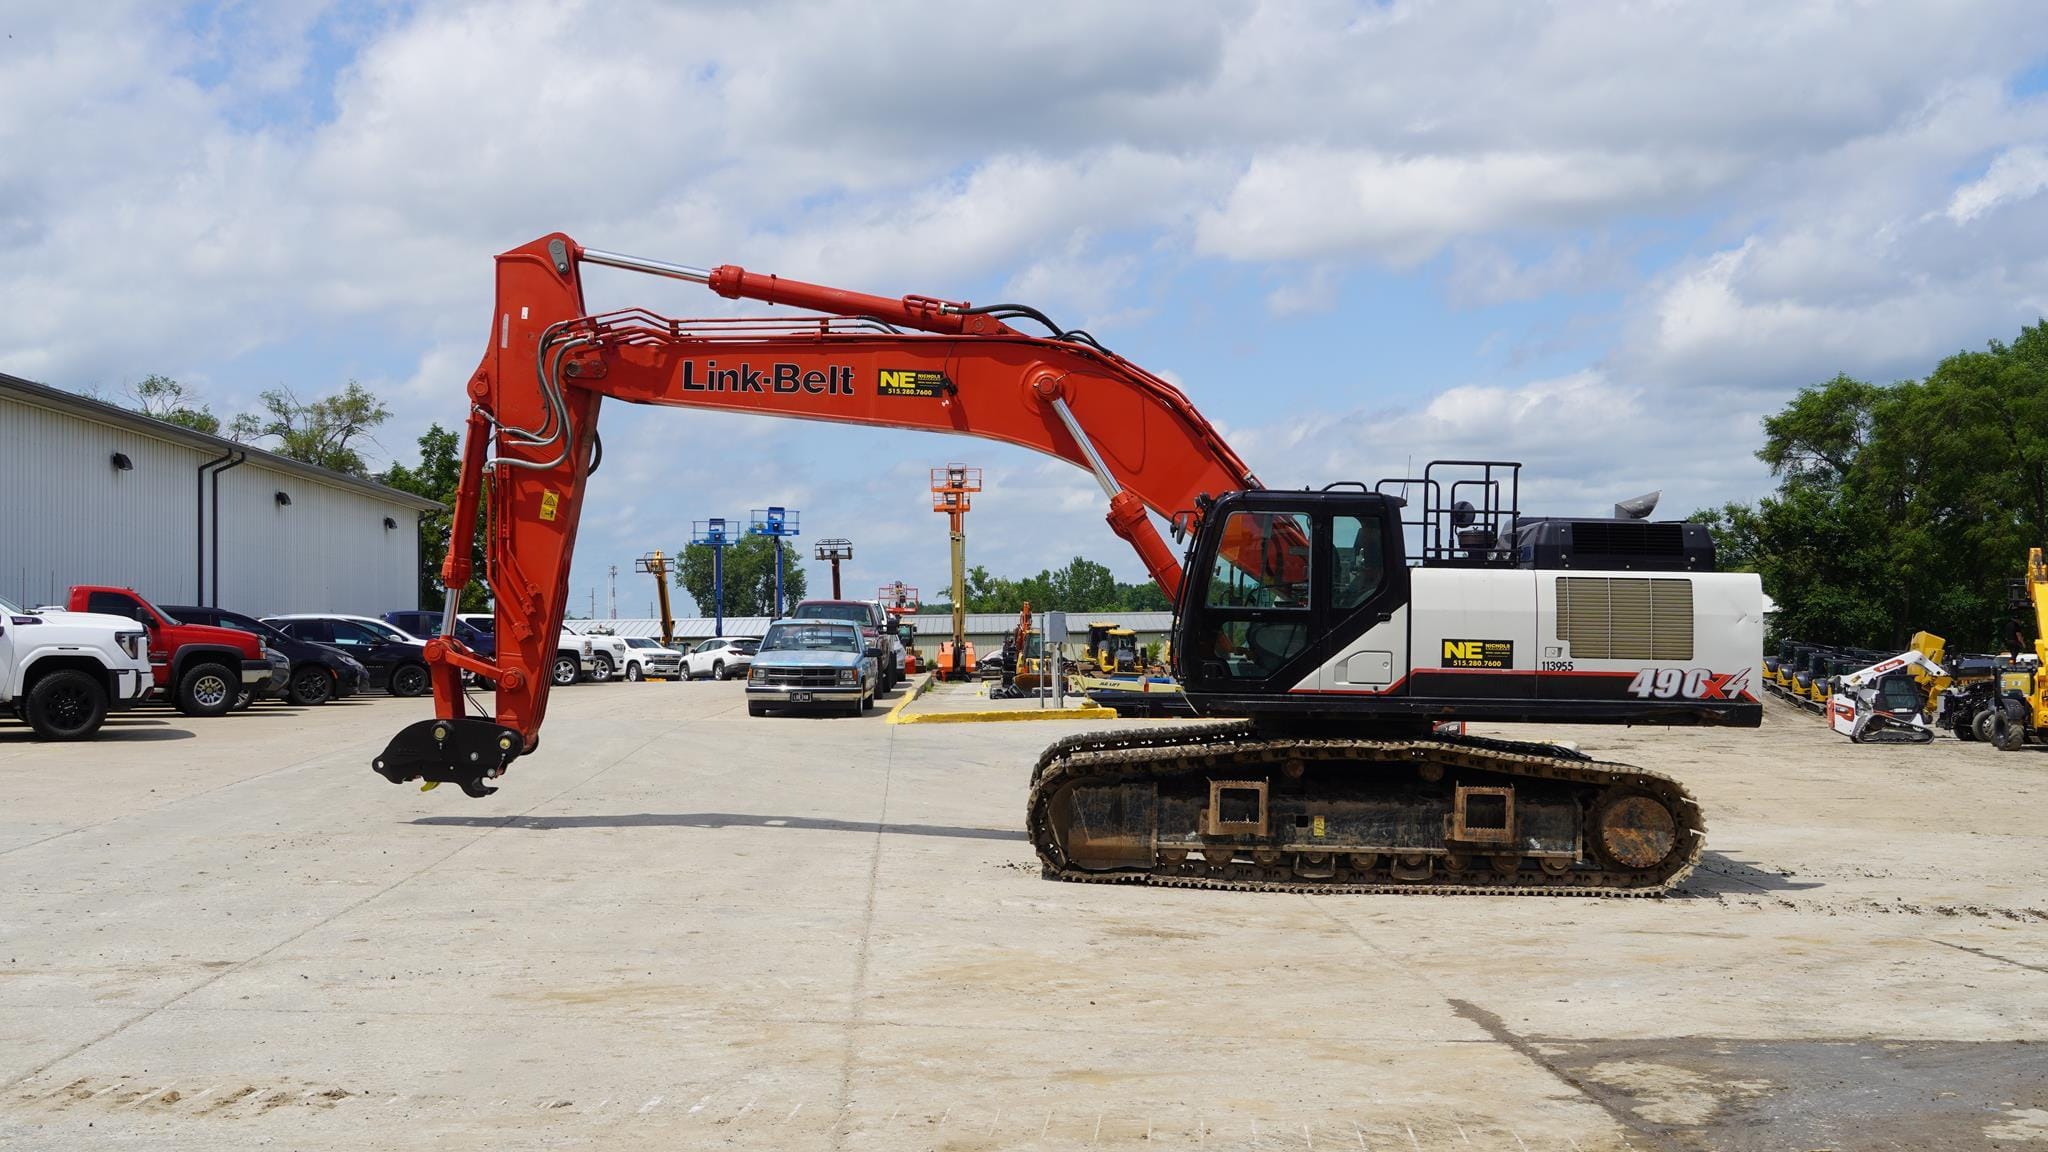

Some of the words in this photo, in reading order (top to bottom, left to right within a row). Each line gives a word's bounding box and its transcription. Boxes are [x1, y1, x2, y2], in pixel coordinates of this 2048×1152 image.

[682, 359, 855, 395] Link-Belt
[880, 371, 916, 389] NE
[888, 388, 932, 396] 515.280.7600
[1444, 641, 1483, 659] NE
[1542, 661, 1574, 672] 113955
